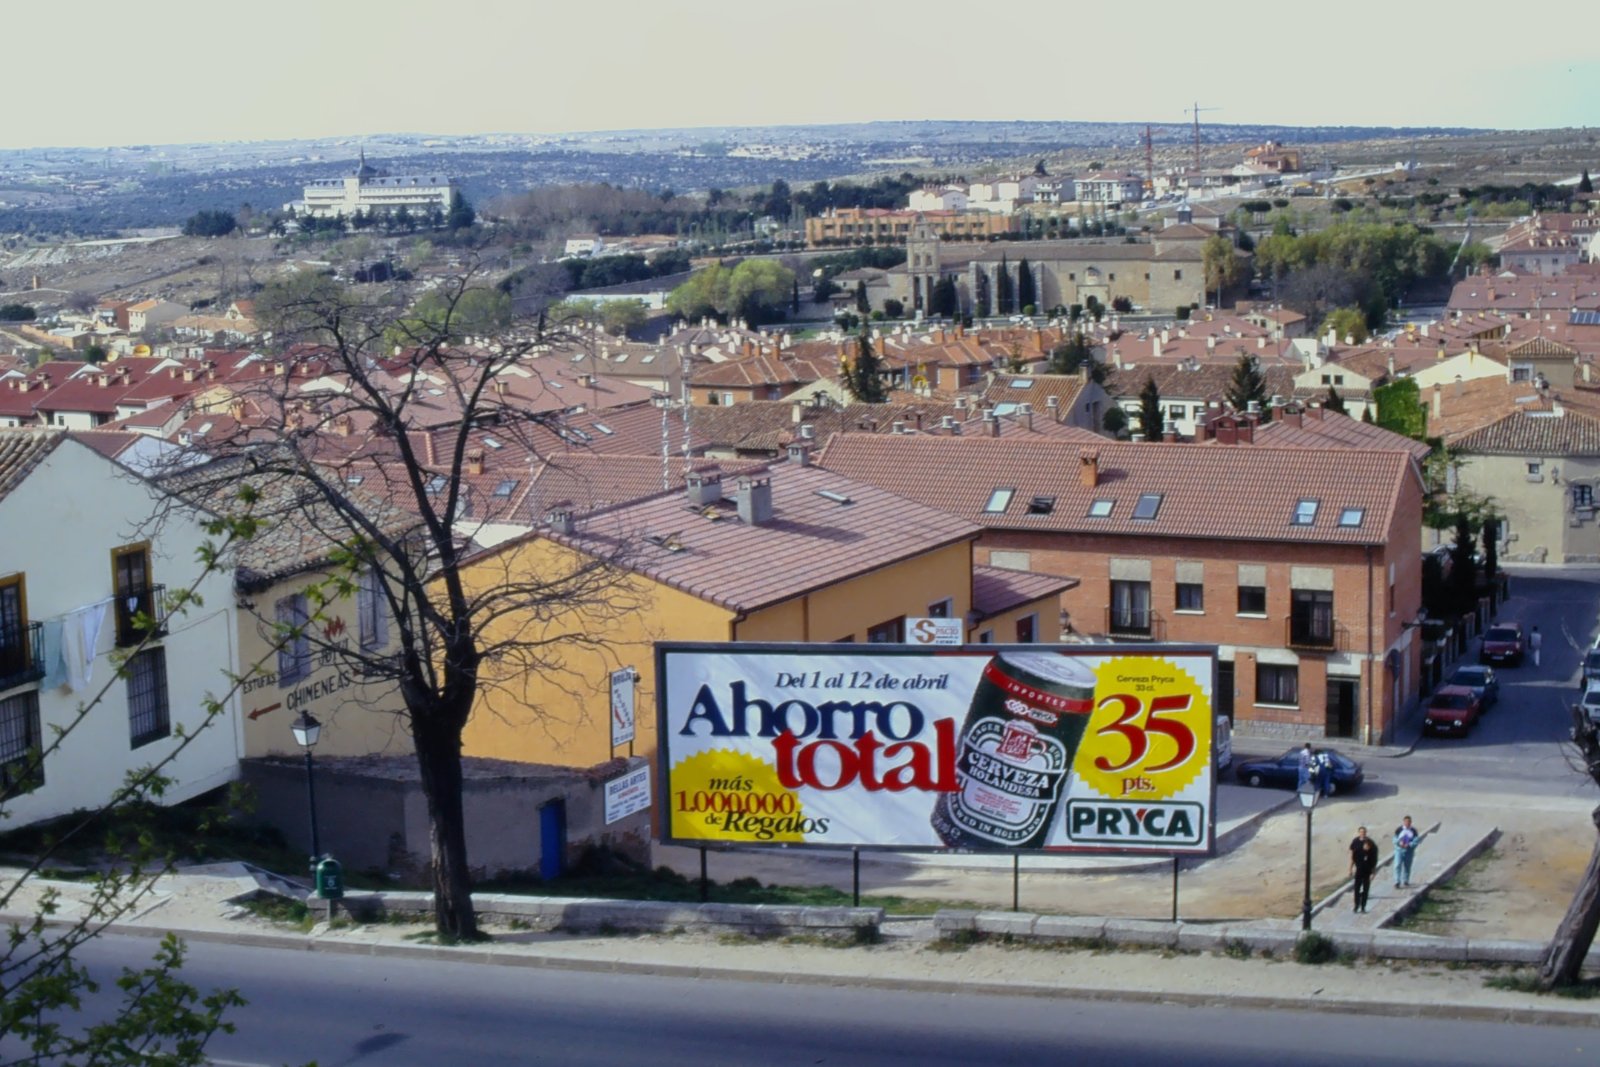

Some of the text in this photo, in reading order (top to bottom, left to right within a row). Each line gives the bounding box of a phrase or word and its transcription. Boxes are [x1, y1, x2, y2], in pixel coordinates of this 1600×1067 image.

[243, 673, 277, 694] ESTUFAS
[286, 671, 350, 710] CHIMENEAS
[775, 671, 949, 690] Del 1 al 12 de abril
[1116, 674, 1175, 684] Cerveza Pryca
[678, 680, 925, 741] Ahorro
[1094, 693, 1197, 773] 35
[771, 717, 964, 792] total
[709, 775, 753, 791] más
[968, 752, 1049, 789] CERVEZA
[969, 766, 1040, 797] HOLANDESA
[1121, 774, 1156, 795] pts.
[705, 811, 830, 840] de Regalos
[979, 822, 992, 832] IN
[1072, 807, 1194, 838] PRYCA
